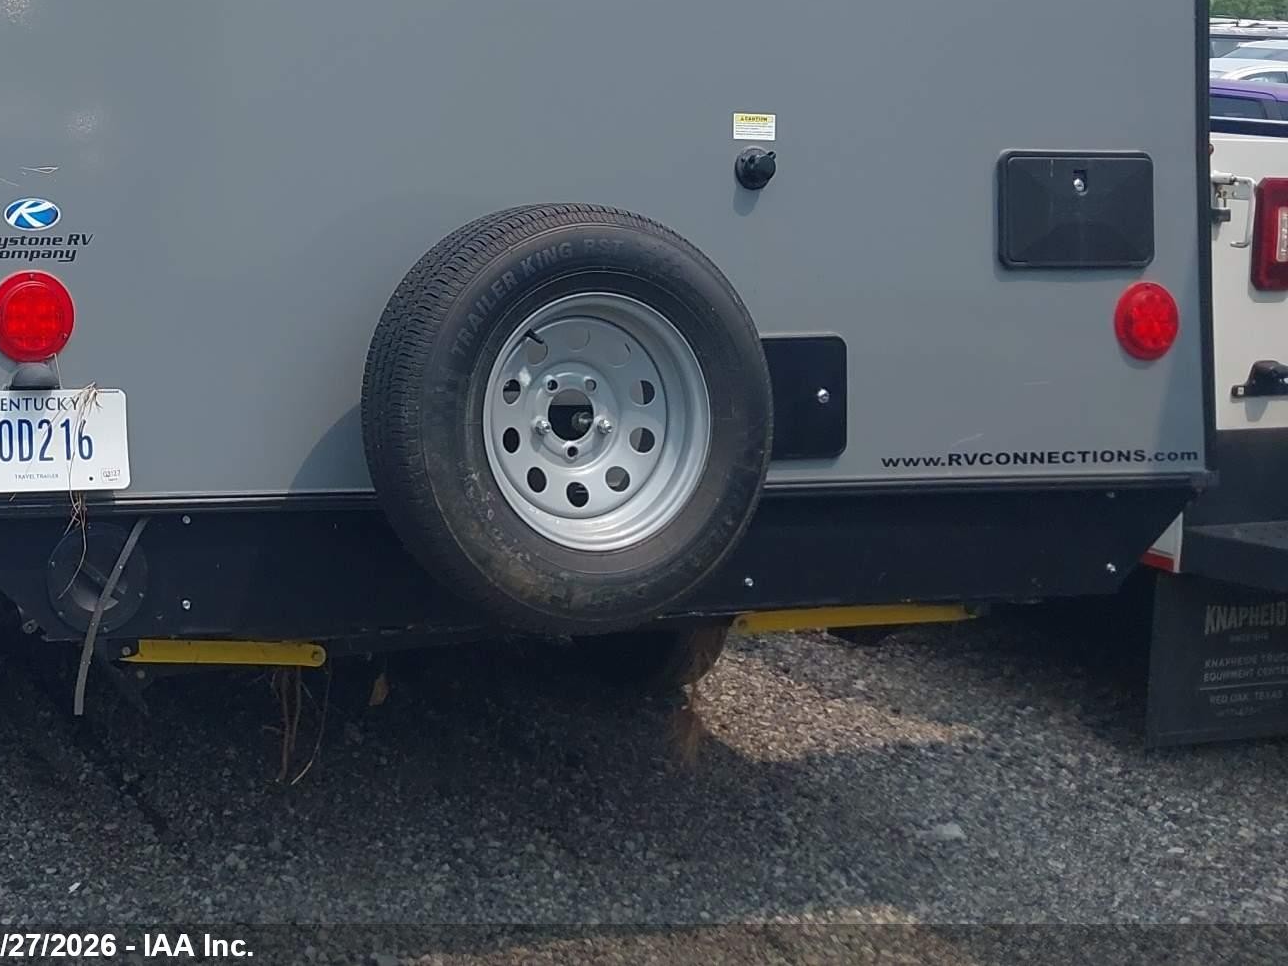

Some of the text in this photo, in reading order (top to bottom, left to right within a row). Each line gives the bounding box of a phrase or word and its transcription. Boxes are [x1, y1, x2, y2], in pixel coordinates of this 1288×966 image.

[67, 233, 94, 246] RV
[451, 271, 514, 360] TRAILER
[520, 241, 574, 278] KING
[880, 449, 1199, 468] www.RVCONNECTIONS.com
